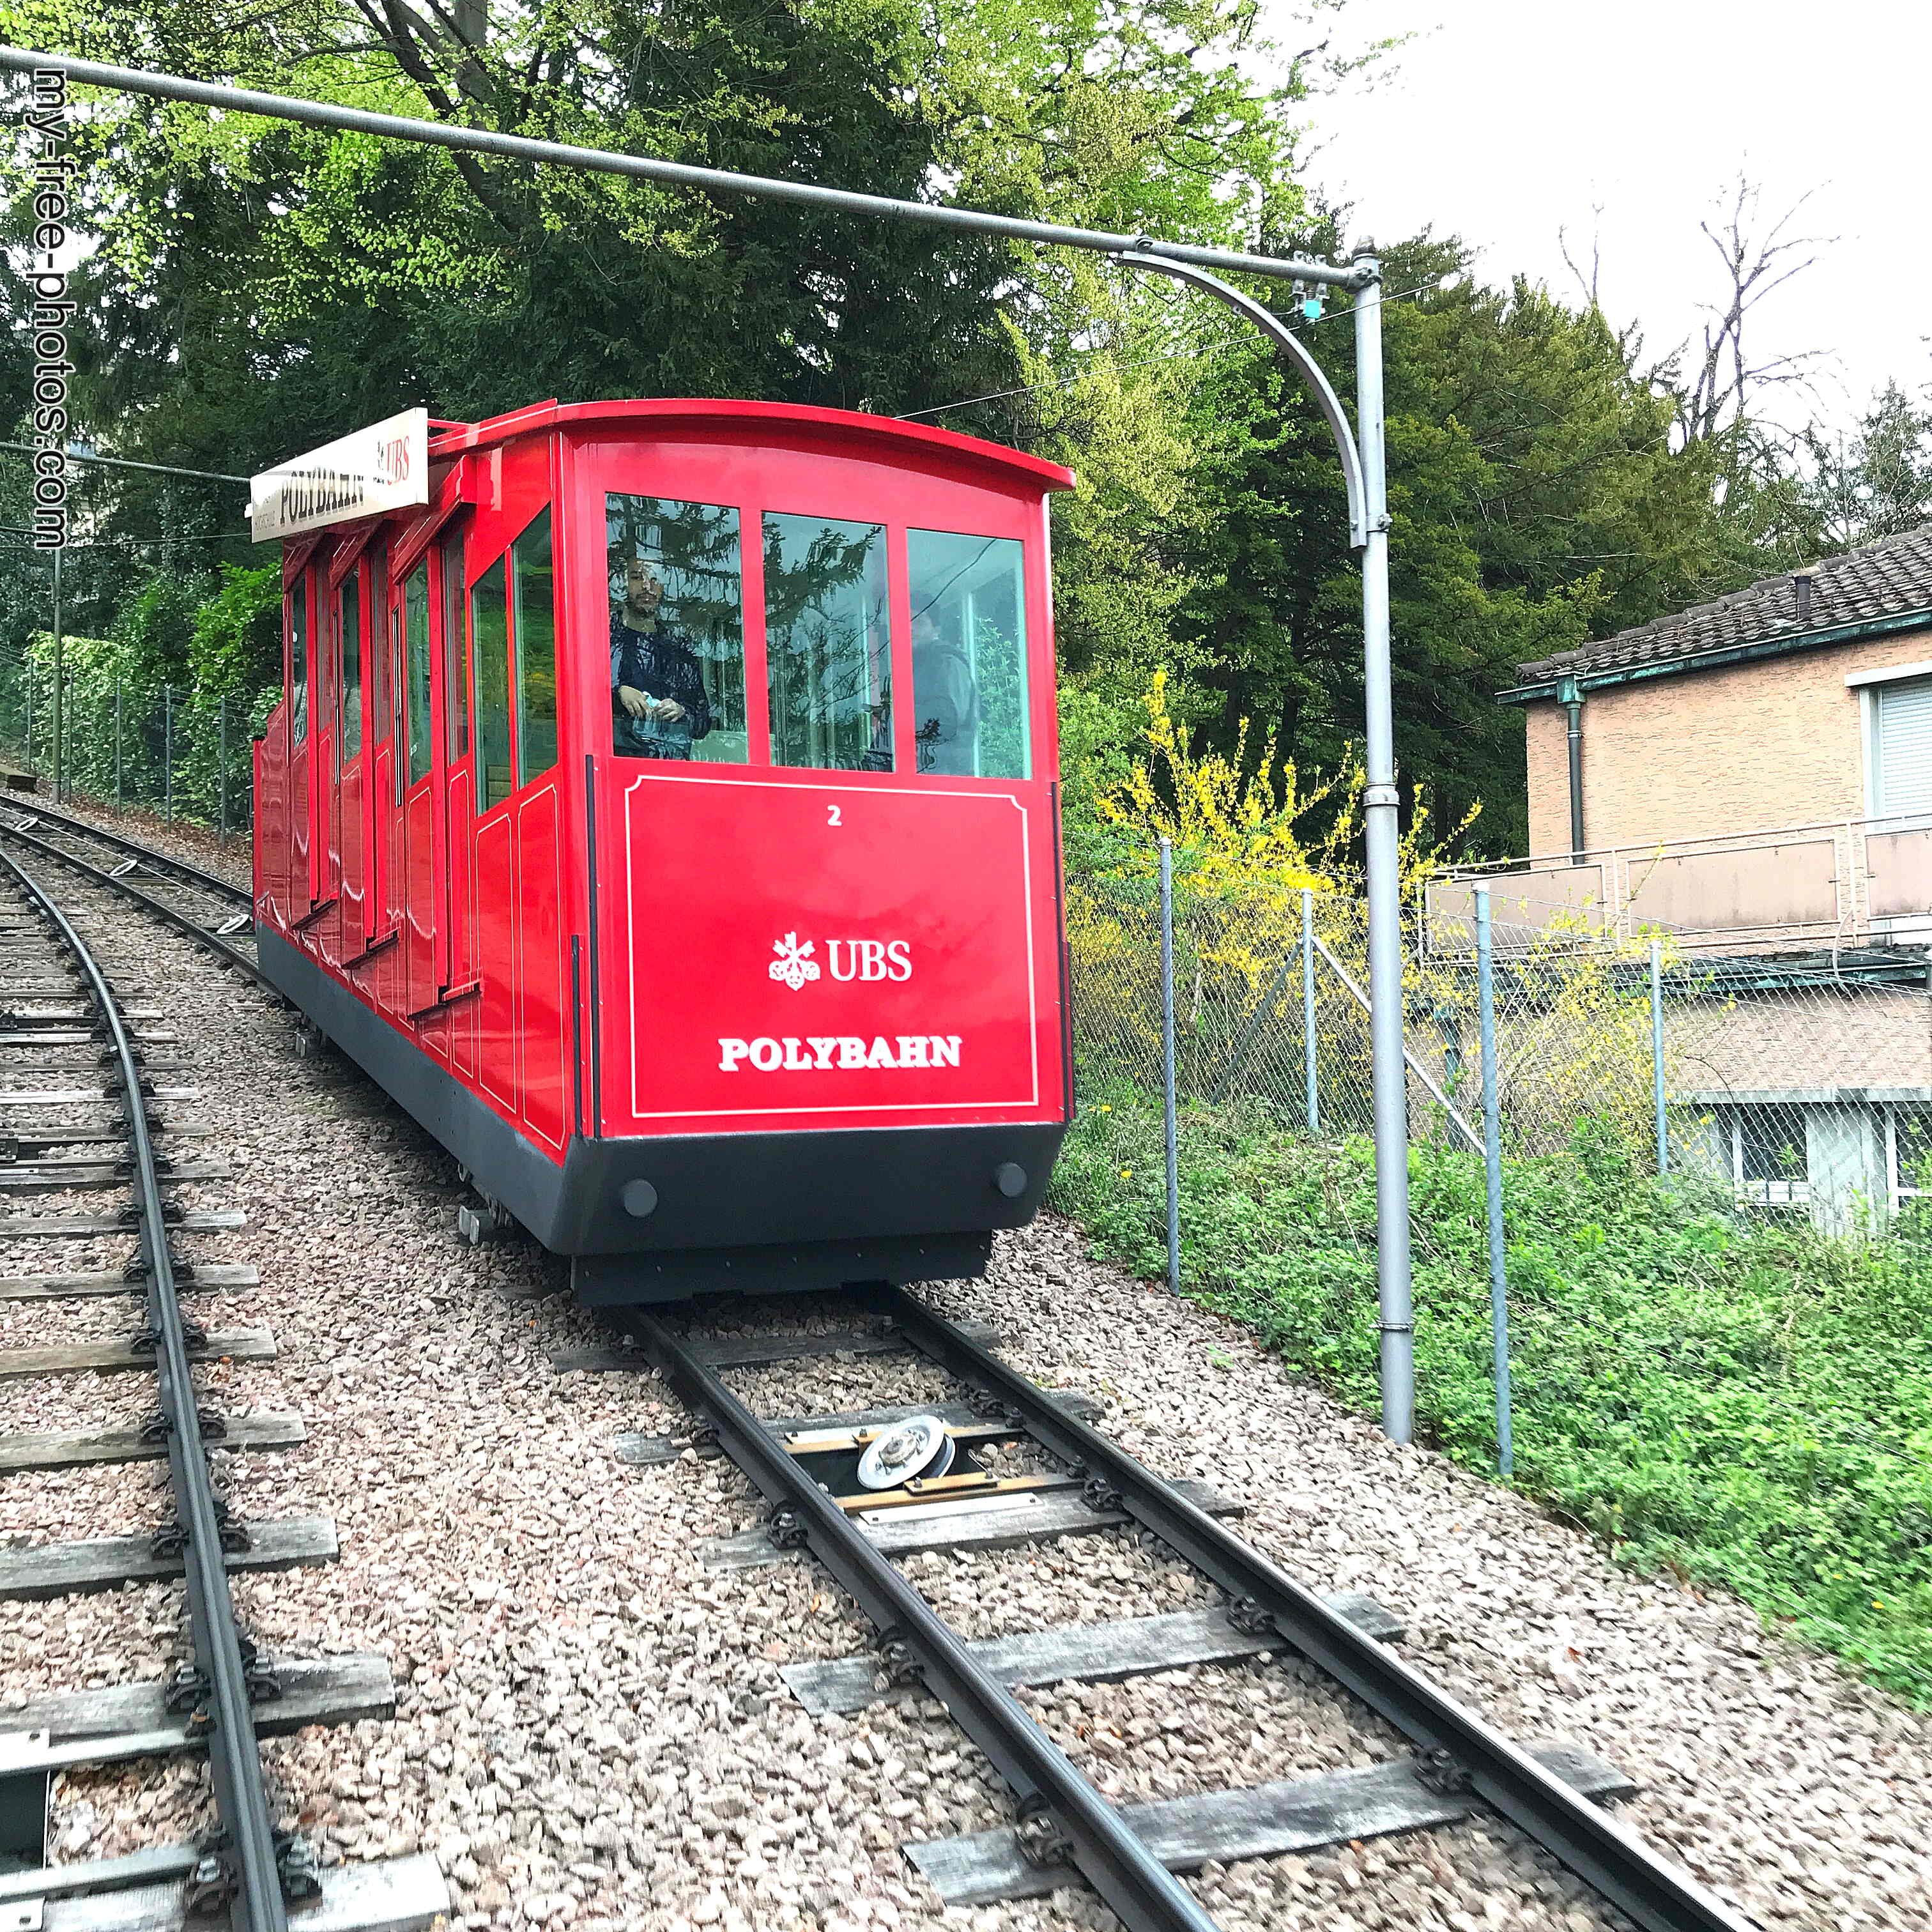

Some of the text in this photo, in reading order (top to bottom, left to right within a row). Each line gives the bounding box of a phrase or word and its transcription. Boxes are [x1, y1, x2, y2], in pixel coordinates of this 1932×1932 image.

[387, 435, 410, 486] UBS
[827, 805, 842, 827] 2
[825, 940, 912, 981] UBS
[717, 1036, 962, 1071] POLYBAHN
